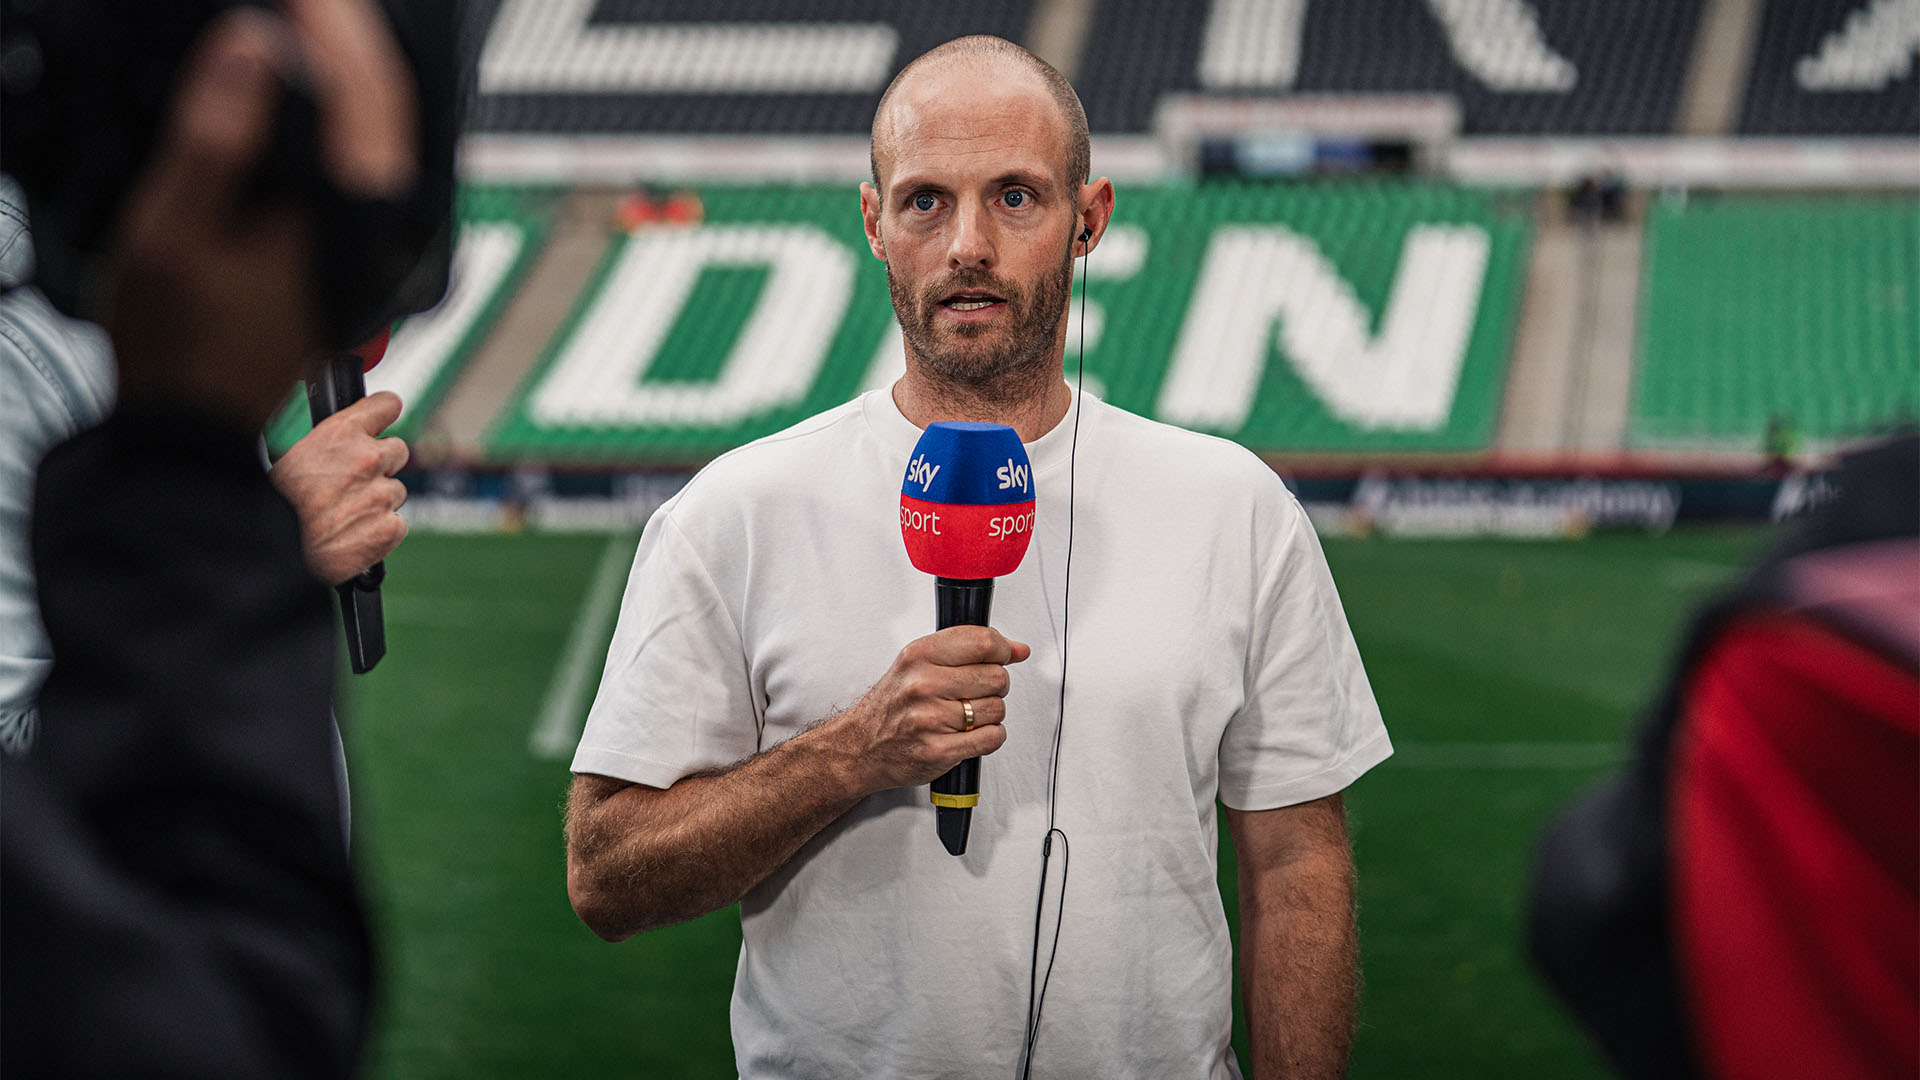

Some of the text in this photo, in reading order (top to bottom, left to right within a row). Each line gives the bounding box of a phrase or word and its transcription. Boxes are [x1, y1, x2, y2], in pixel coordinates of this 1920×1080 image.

[907, 454, 940, 492] sky
[996, 458, 1028, 493] sky
[988, 508, 1035, 541] sport
